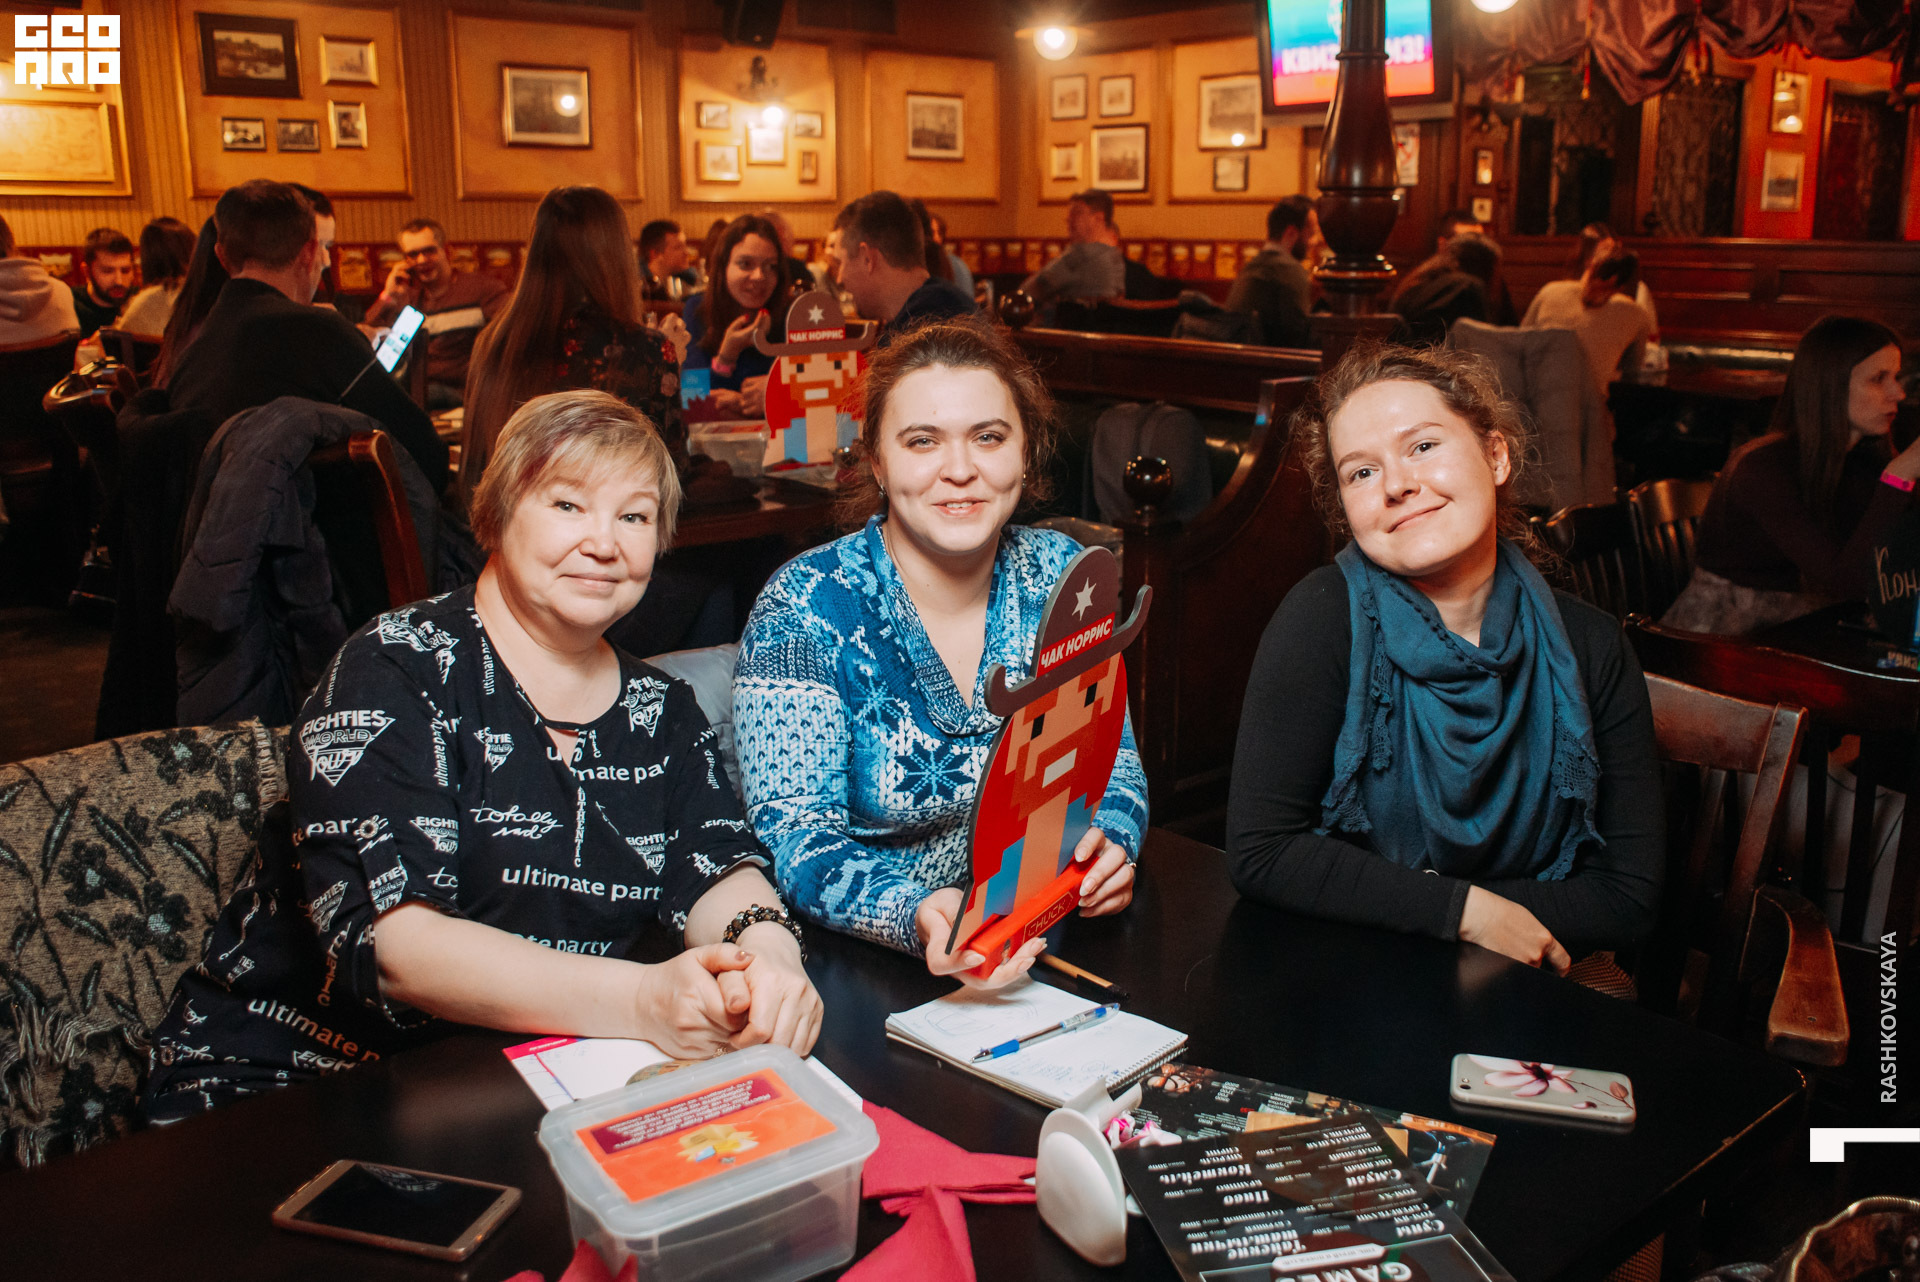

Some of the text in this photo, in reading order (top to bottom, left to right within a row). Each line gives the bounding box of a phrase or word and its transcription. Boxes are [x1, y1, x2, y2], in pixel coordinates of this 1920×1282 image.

[1385, 35, 1425, 65] ИЗ!
[789, 329, 844, 342] ЧАК НОРРИС
[1041, 618, 1112, 668] ЧАК НОРРИС
[482, 654, 494, 694] ultimate
[301, 709, 387, 736] EIGHTIES
[430, 717, 447, 786] ultimate party
[469, 800, 564, 834] totally
[501, 865, 664, 902] ultimate part
[249, 999, 359, 1057] ultimate
[1160, 1164, 1250, 1183] Коктейль
[1346, 1168, 1401, 1186] Смузи
[1223, 1190, 1268, 1204] Пиво
[1191, 1230, 1297, 1252] шашлычки
[1396, 1219, 1444, 1236] Супы
[1228, 1240, 1305, 1258] Тайские
